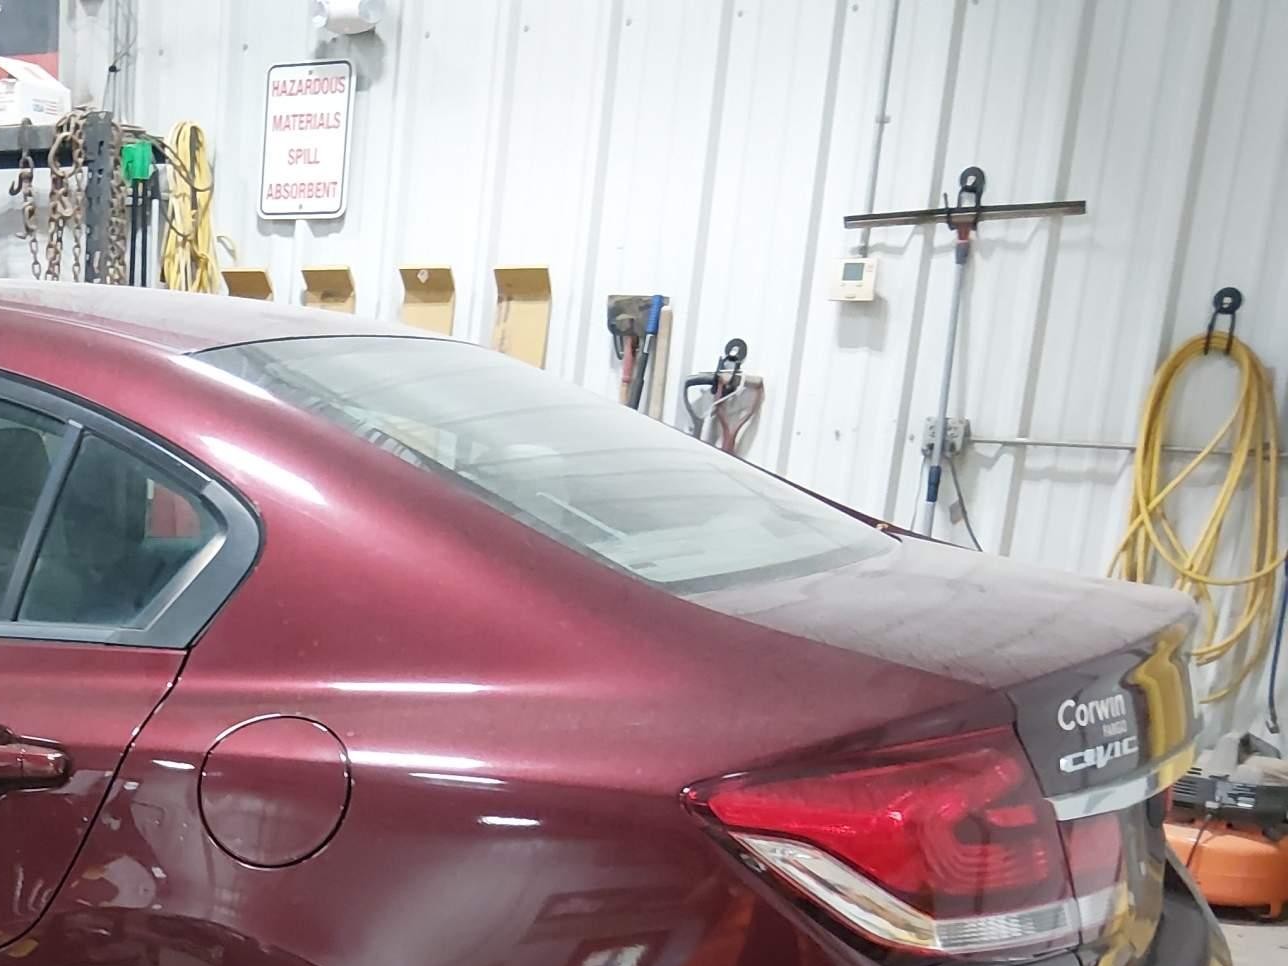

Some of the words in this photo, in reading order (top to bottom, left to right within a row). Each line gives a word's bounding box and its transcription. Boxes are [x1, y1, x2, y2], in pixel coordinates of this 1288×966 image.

[272, 76, 346, 97] HAZARDOUS
[272, 112, 341, 132] MATERIALS
[288, 148, 320, 165] SPILL
[266, 181, 338, 200] ABSORBENT
[1058, 694, 1126, 731] Corwin
[1059, 735, 1139, 773] CIVIC
